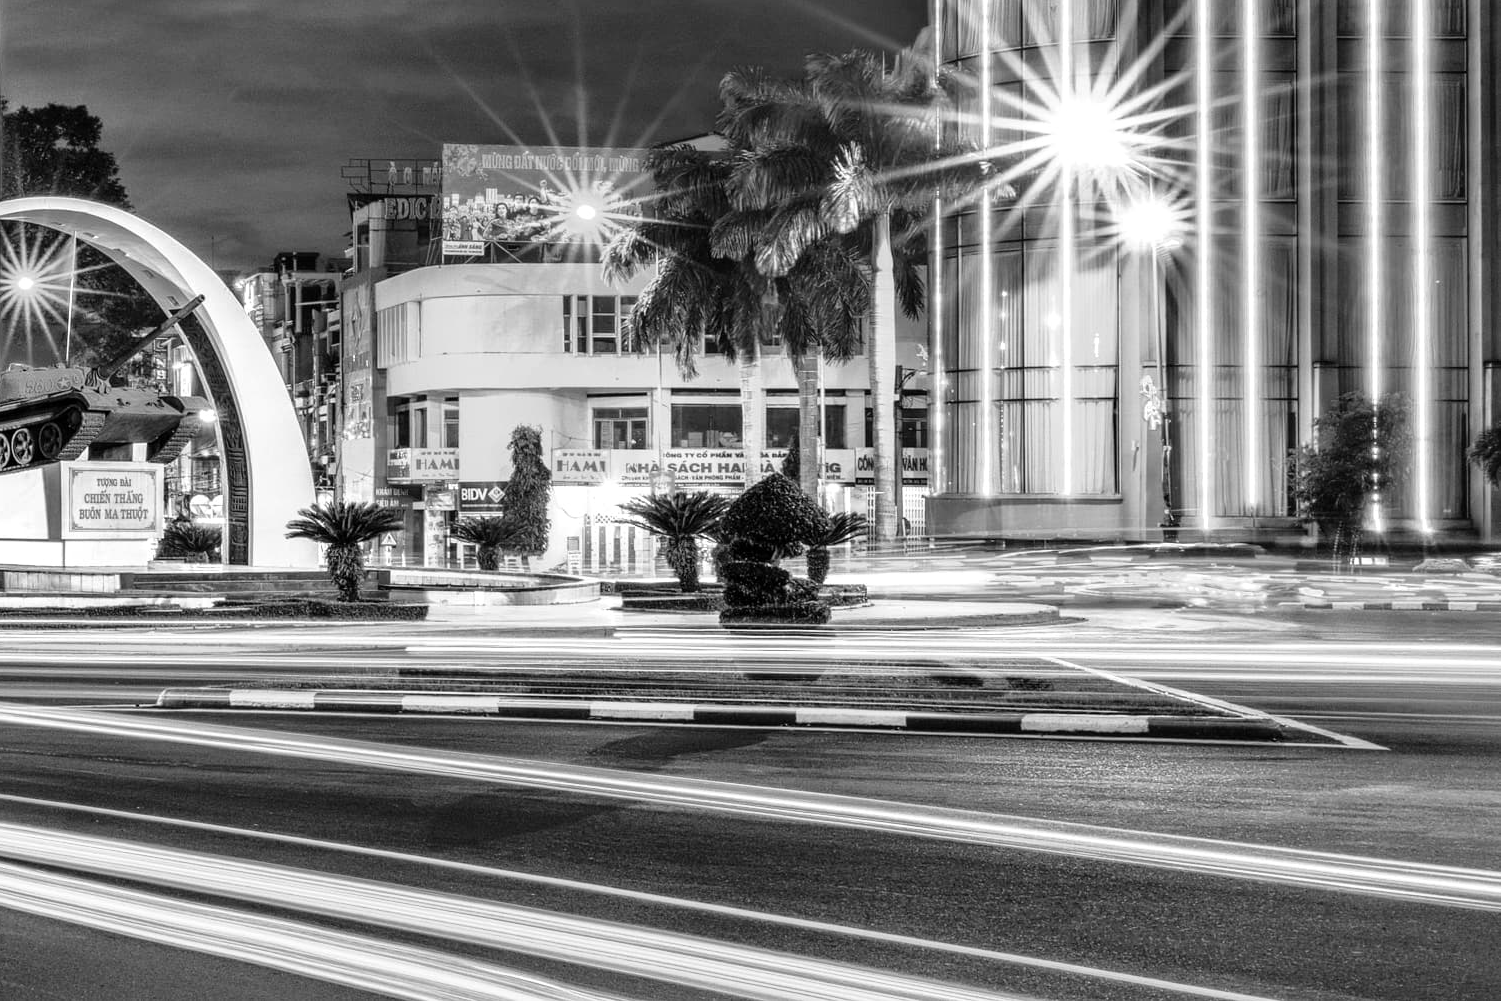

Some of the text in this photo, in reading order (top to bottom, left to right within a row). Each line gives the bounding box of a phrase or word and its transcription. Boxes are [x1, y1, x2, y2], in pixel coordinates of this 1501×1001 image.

[482, 152, 512, 169] MỪNG
[514, 151, 534, 169] ĐẤT
[609, 155, 639, 172] MỪNG
[625, 460, 660, 473] NHÀ
[667, 460, 713, 473] SÁCH
[96, 476, 132, 488] TƯỢNG ĐÀI
[84, 489, 144, 503] CHIẾN THẮNG
[461, 488, 488, 501] BIDV
[79, 506, 149, 522] BUÔN MA THUỘT
